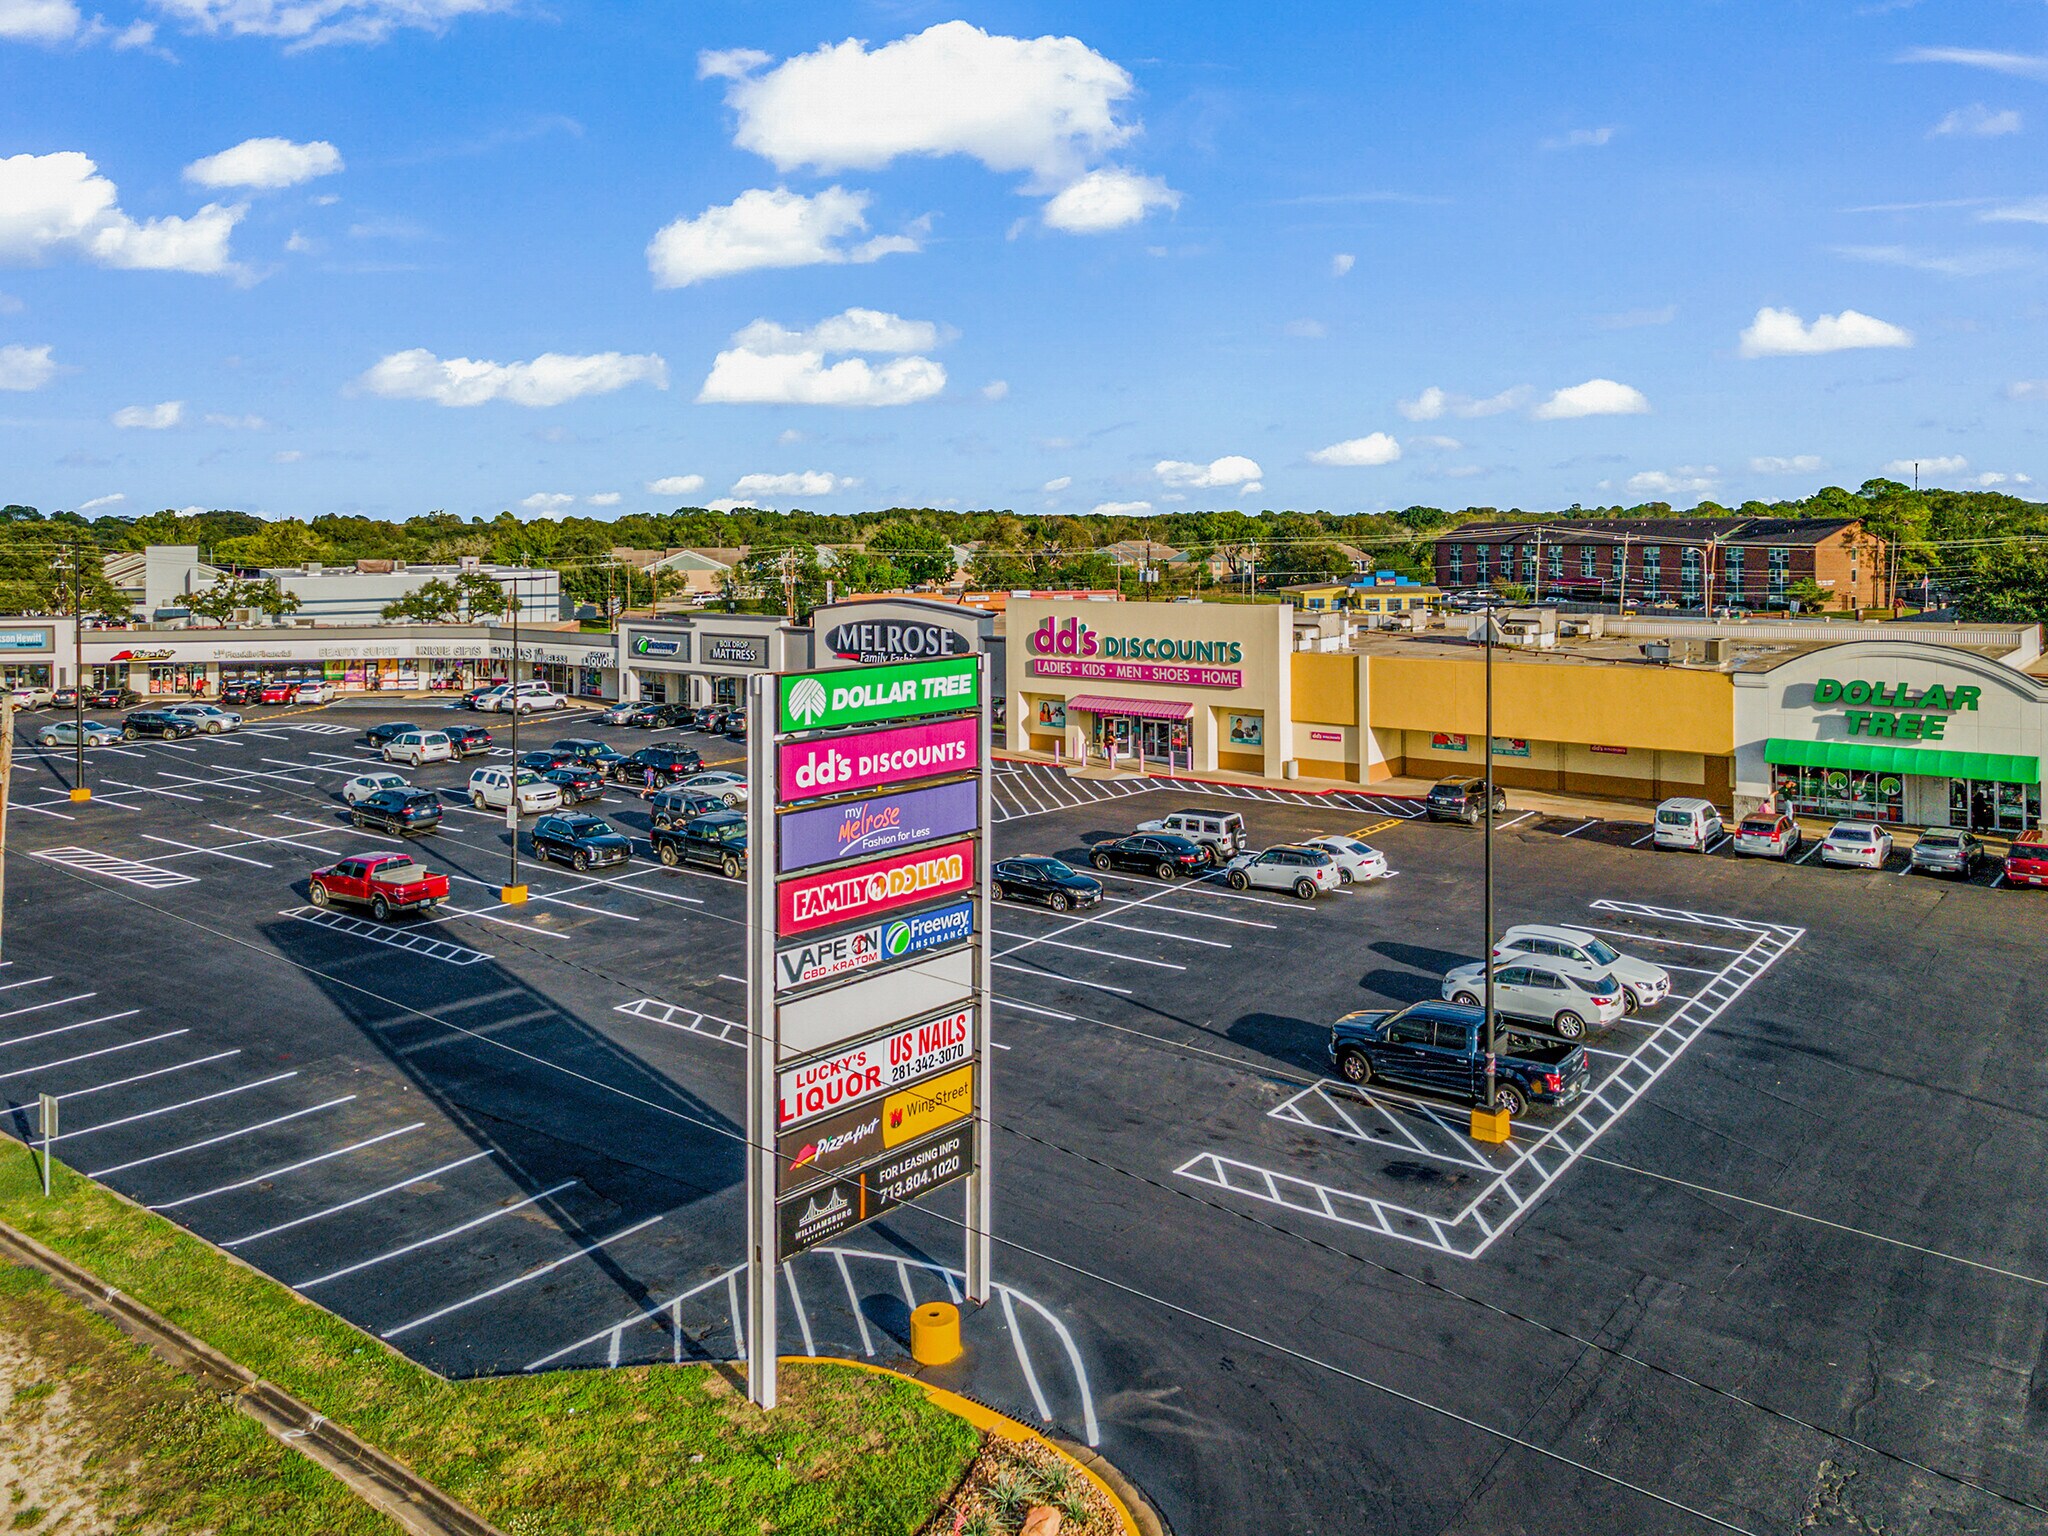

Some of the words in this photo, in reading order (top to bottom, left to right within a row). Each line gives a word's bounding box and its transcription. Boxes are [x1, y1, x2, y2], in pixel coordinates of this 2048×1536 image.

[319, 646, 359, 657] BEAUTY
[362, 645, 400, 656] SUPPLY
[415, 646, 450, 656] UNIQUE
[453, 645, 482, 656] GIFTS
[500, 647, 532, 660] NALS
[712, 648, 756, 660] MATTRESS
[719, 640, 731, 648] BOX
[731, 640, 749, 649] DROP
[836, 624, 954, 655] MELROSE
[1033, 616, 1099, 656] dd's
[1105, 636, 1244, 664] DISCOUNTS
[582, 657, 615, 668] LIQUOR
[860, 652, 888, 663] Family
[1037, 661, 1072, 674] LADIES
[1081, 663, 1106, 676] KIDS
[1116, 665, 1142, 679] MEN
[1152, 667, 1190, 682] SHOES
[1201, 670, 1239, 685] HOME
[831, 680, 917, 711] DOLLAR
[921, 673, 972, 699] TREE
[1813, 678, 1982, 711] DOLLAR
[1844, 709, 1948, 741] TREE
[795, 749, 852, 788] dd's
[858, 740, 966, 777] DISCOUNTS
[837, 803, 900, 843] Melrose
[845, 806, 863, 819] my
[862, 834, 896, 849] Fashion
[897, 831, 911, 842] for
[911, 827, 930, 838] Less
[793, 874, 873, 922] FAMILY
[888, 854, 963, 898] DOLLAR
[910, 910, 969, 938] Freeway
[911, 926, 969, 950] INSURANCE
[780, 938, 847, 985] VAPE
[889, 1032, 912, 1066] US
[918, 1014, 966, 1056] NAILS
[796, 1051, 867, 1089] LUCKY'S
[891, 1043, 964, 1083] 281-342-3070
[780, 1065, 882, 1123] LIQUOR
[906, 1081, 969, 1117] WingStreet
[814, 1132, 853, 1162] Pizza
[852, 1117, 880, 1145] Hut
[879, 1167, 899, 1184] FOR
[900, 1150, 938, 1176] LEASING
[939, 1137, 960, 1157] INFO
[878, 1155, 960, 1205] 713.804.1020
[794, 1208, 852, 1241] WILLIAMSBURG
